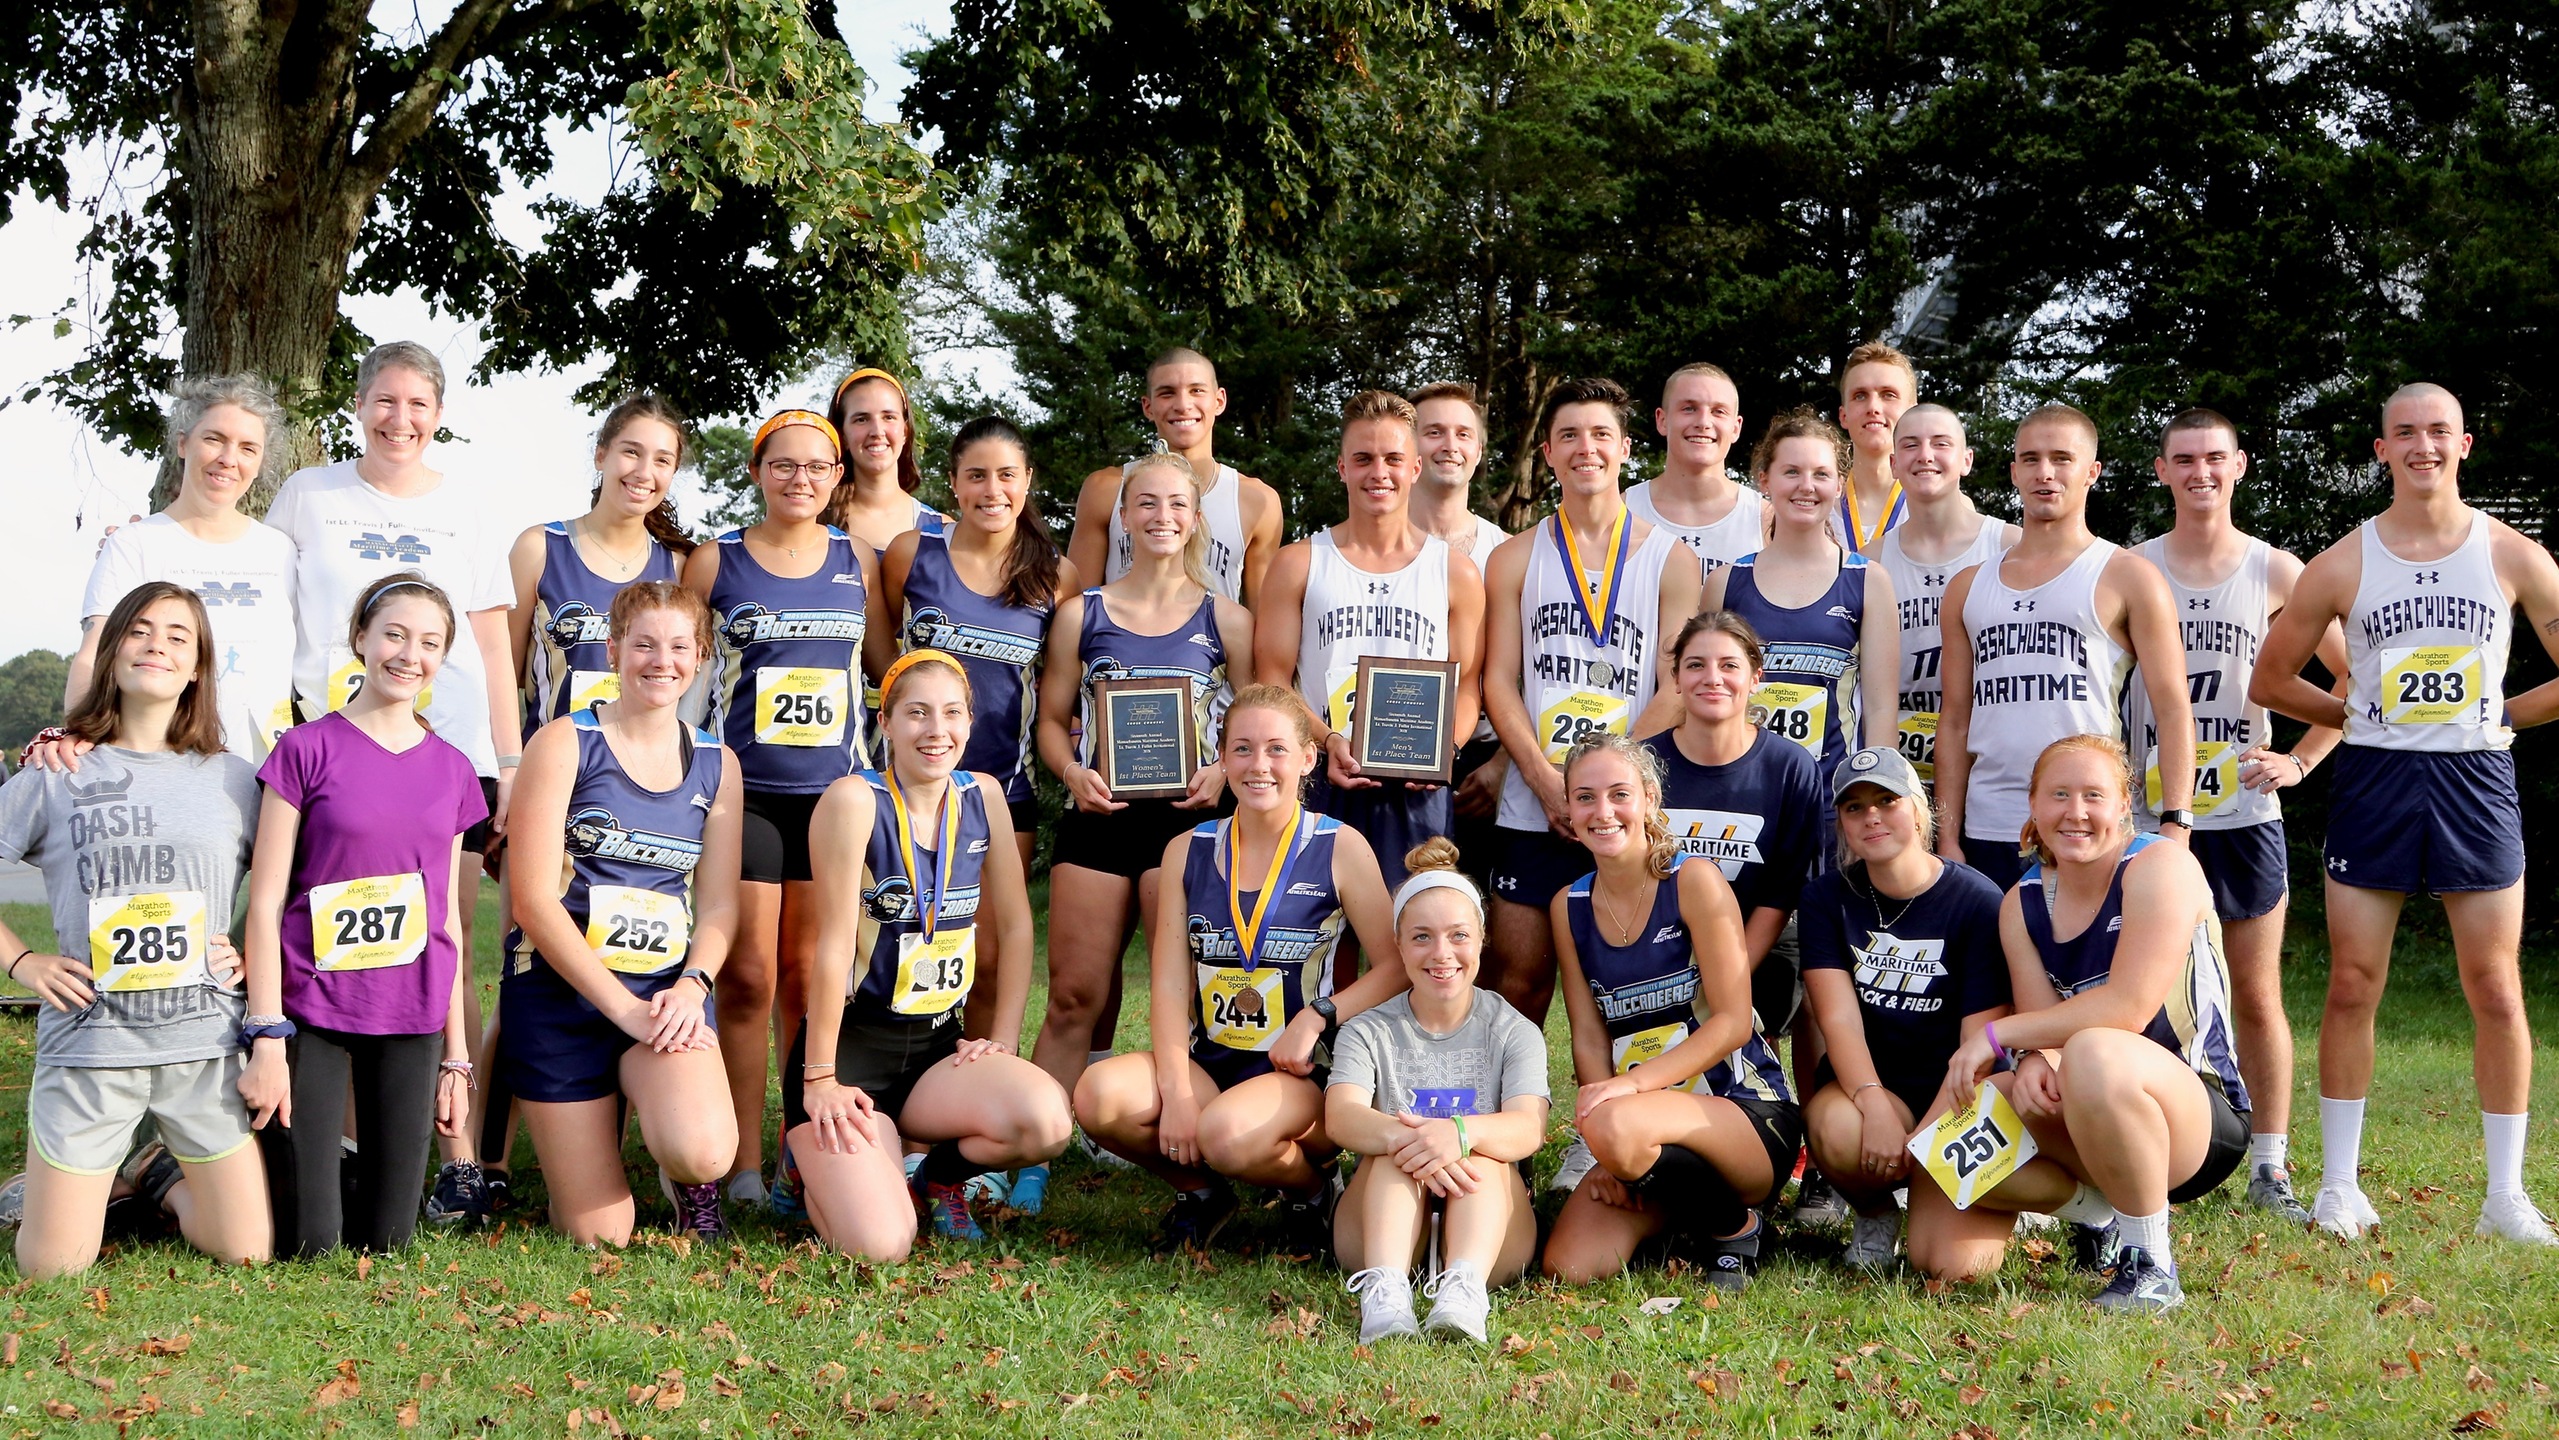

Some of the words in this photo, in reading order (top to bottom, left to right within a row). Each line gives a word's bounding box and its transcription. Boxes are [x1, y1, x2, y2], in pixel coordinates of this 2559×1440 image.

[746, 614, 866, 640] BUCCANEERS
[1317, 605, 1436, 657] MASSACHUSETTS
[2361, 596, 2496, 649] MASSACHUSETTS
[929, 623, 1041, 665] BUCCANEERS
[1530, 602, 1644, 665] MASSACHETTS
[1760, 648, 1850, 677] UCCANEERS
[1533, 653, 1638, 696] MARITME
[1764, 688, 1799, 696] Marathon
[1974, 674, 2087, 707] MARITIME
[2399, 672, 2464, 703] 283
[773, 694, 833, 725] 256
[1570, 696, 1604, 708] Marathon
[1580, 704, 1603, 714] Sports
[1775, 695, 1798, 703] Sports
[1552, 714, 1607, 745] 28
[1384, 750, 1406, 758] Place
[1409, 752, 1431, 760] Team
[1391, 743, 1413, 751] Men's
[1119, 772, 1129, 780] 1st
[1131, 771, 1153, 779] Place
[1132, 763, 1164, 771] Women's
[68, 805, 156, 850] DASH
[1680, 839, 1750, 859] ARITIME
[76, 845, 176, 895] CLIMB
[347, 885, 388, 894] Marathon
[362, 891, 390, 900] Sports
[127, 902, 171, 911] Marathon
[142, 909, 172, 919] Sports
[335, 905, 406, 946] 287
[606, 914, 669, 953] 252
[1282, 931, 1317, 940] MARITIME
[112, 925, 188, 965] 285
[933, 938, 957, 946] arathon
[1196, 932, 1322, 960] BUCNEERS
[1865, 954, 1937, 974] MARITIME
[1216, 973, 1251, 982] Marathon
[1616, 983, 1658, 999] MASSACHUSETTS
[1658, 972, 1692, 989] MARITIME
[1598, 980, 1698, 1019] BUCCANEERS
[1885, 995, 1898, 1009] &
[1901, 996, 1943, 1012] FIELD
[1631, 1036, 1660, 1048] Marathon
[1641, 1042, 1662, 1053] Sports
[1952, 1109, 1976, 1130] Sports
[1944, 1116, 2009, 1179] 251
